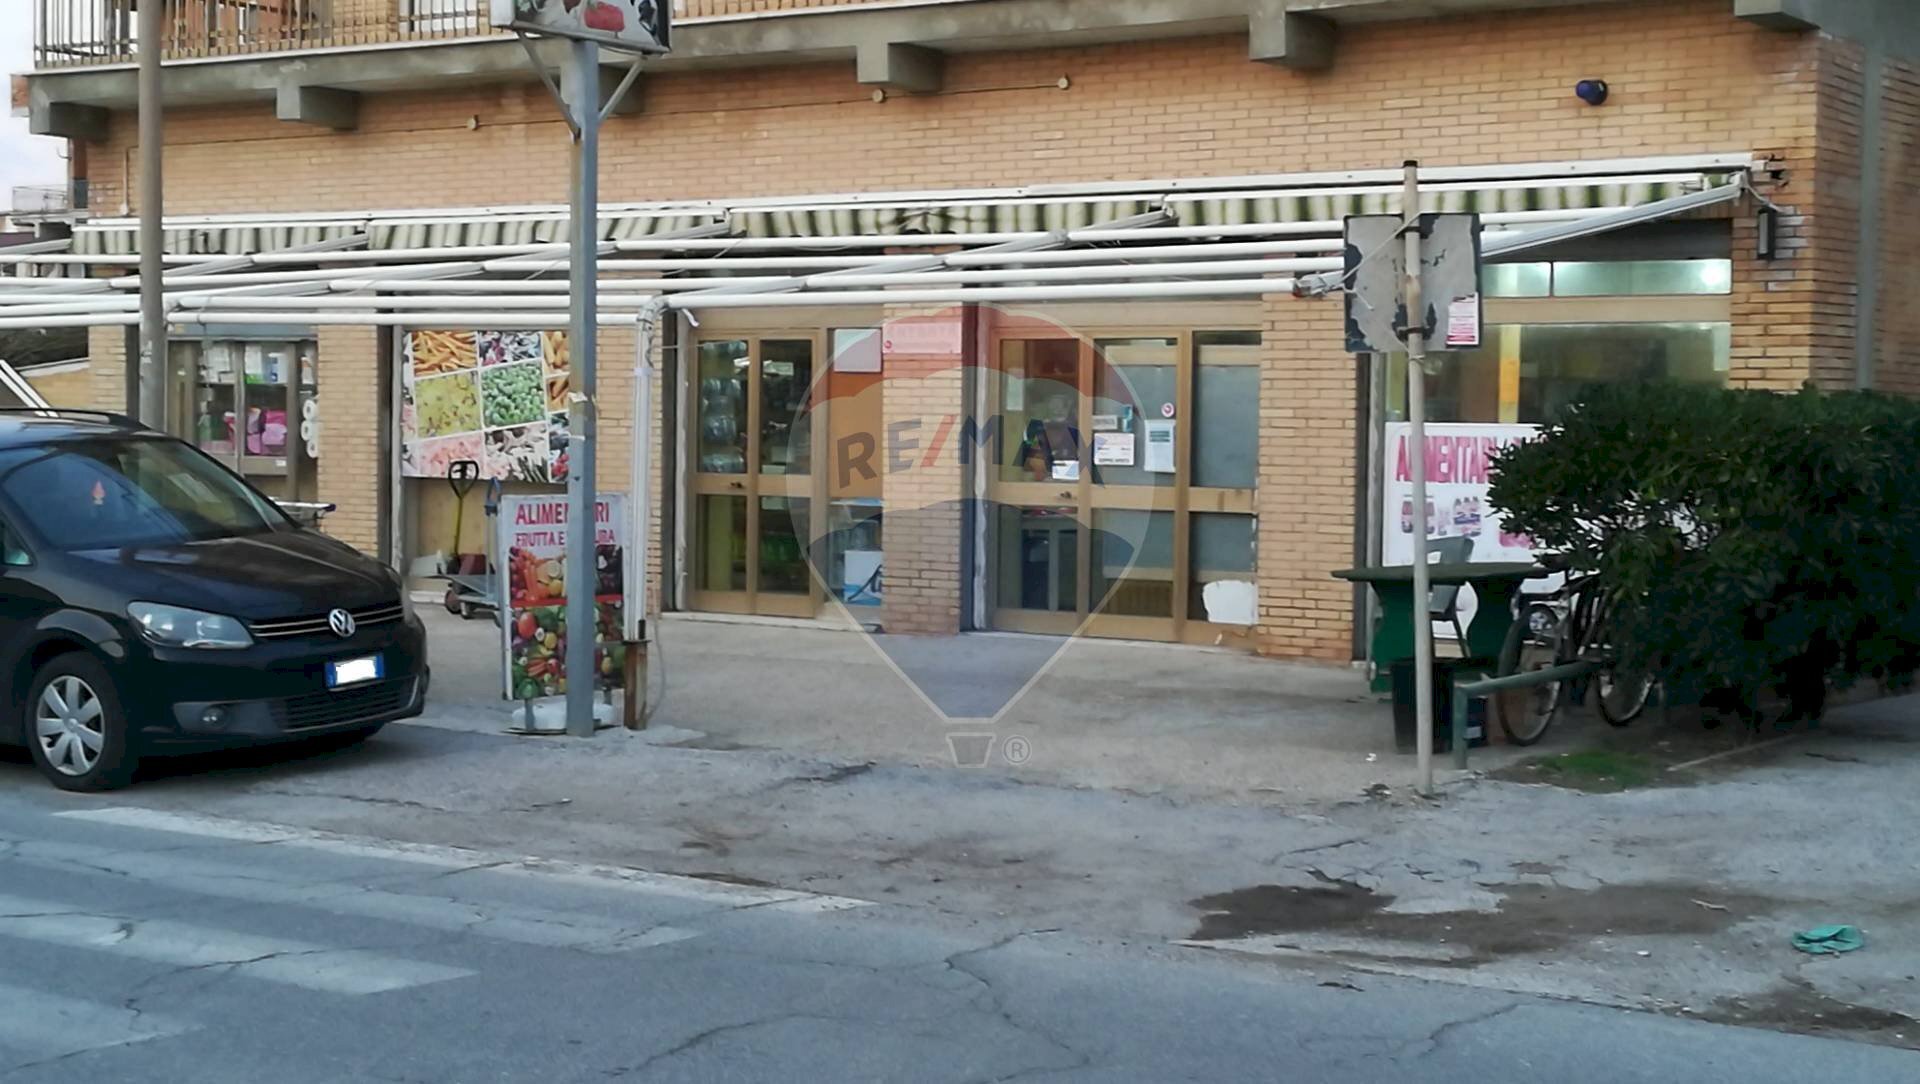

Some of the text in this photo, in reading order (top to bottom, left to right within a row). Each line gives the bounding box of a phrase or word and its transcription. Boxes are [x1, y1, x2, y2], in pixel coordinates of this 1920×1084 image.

[1396, 436, 1498, 484] AMENTAR
[515, 502, 609, 525] ALIMERI
[515, 531, 565, 546] FRUTTA E
